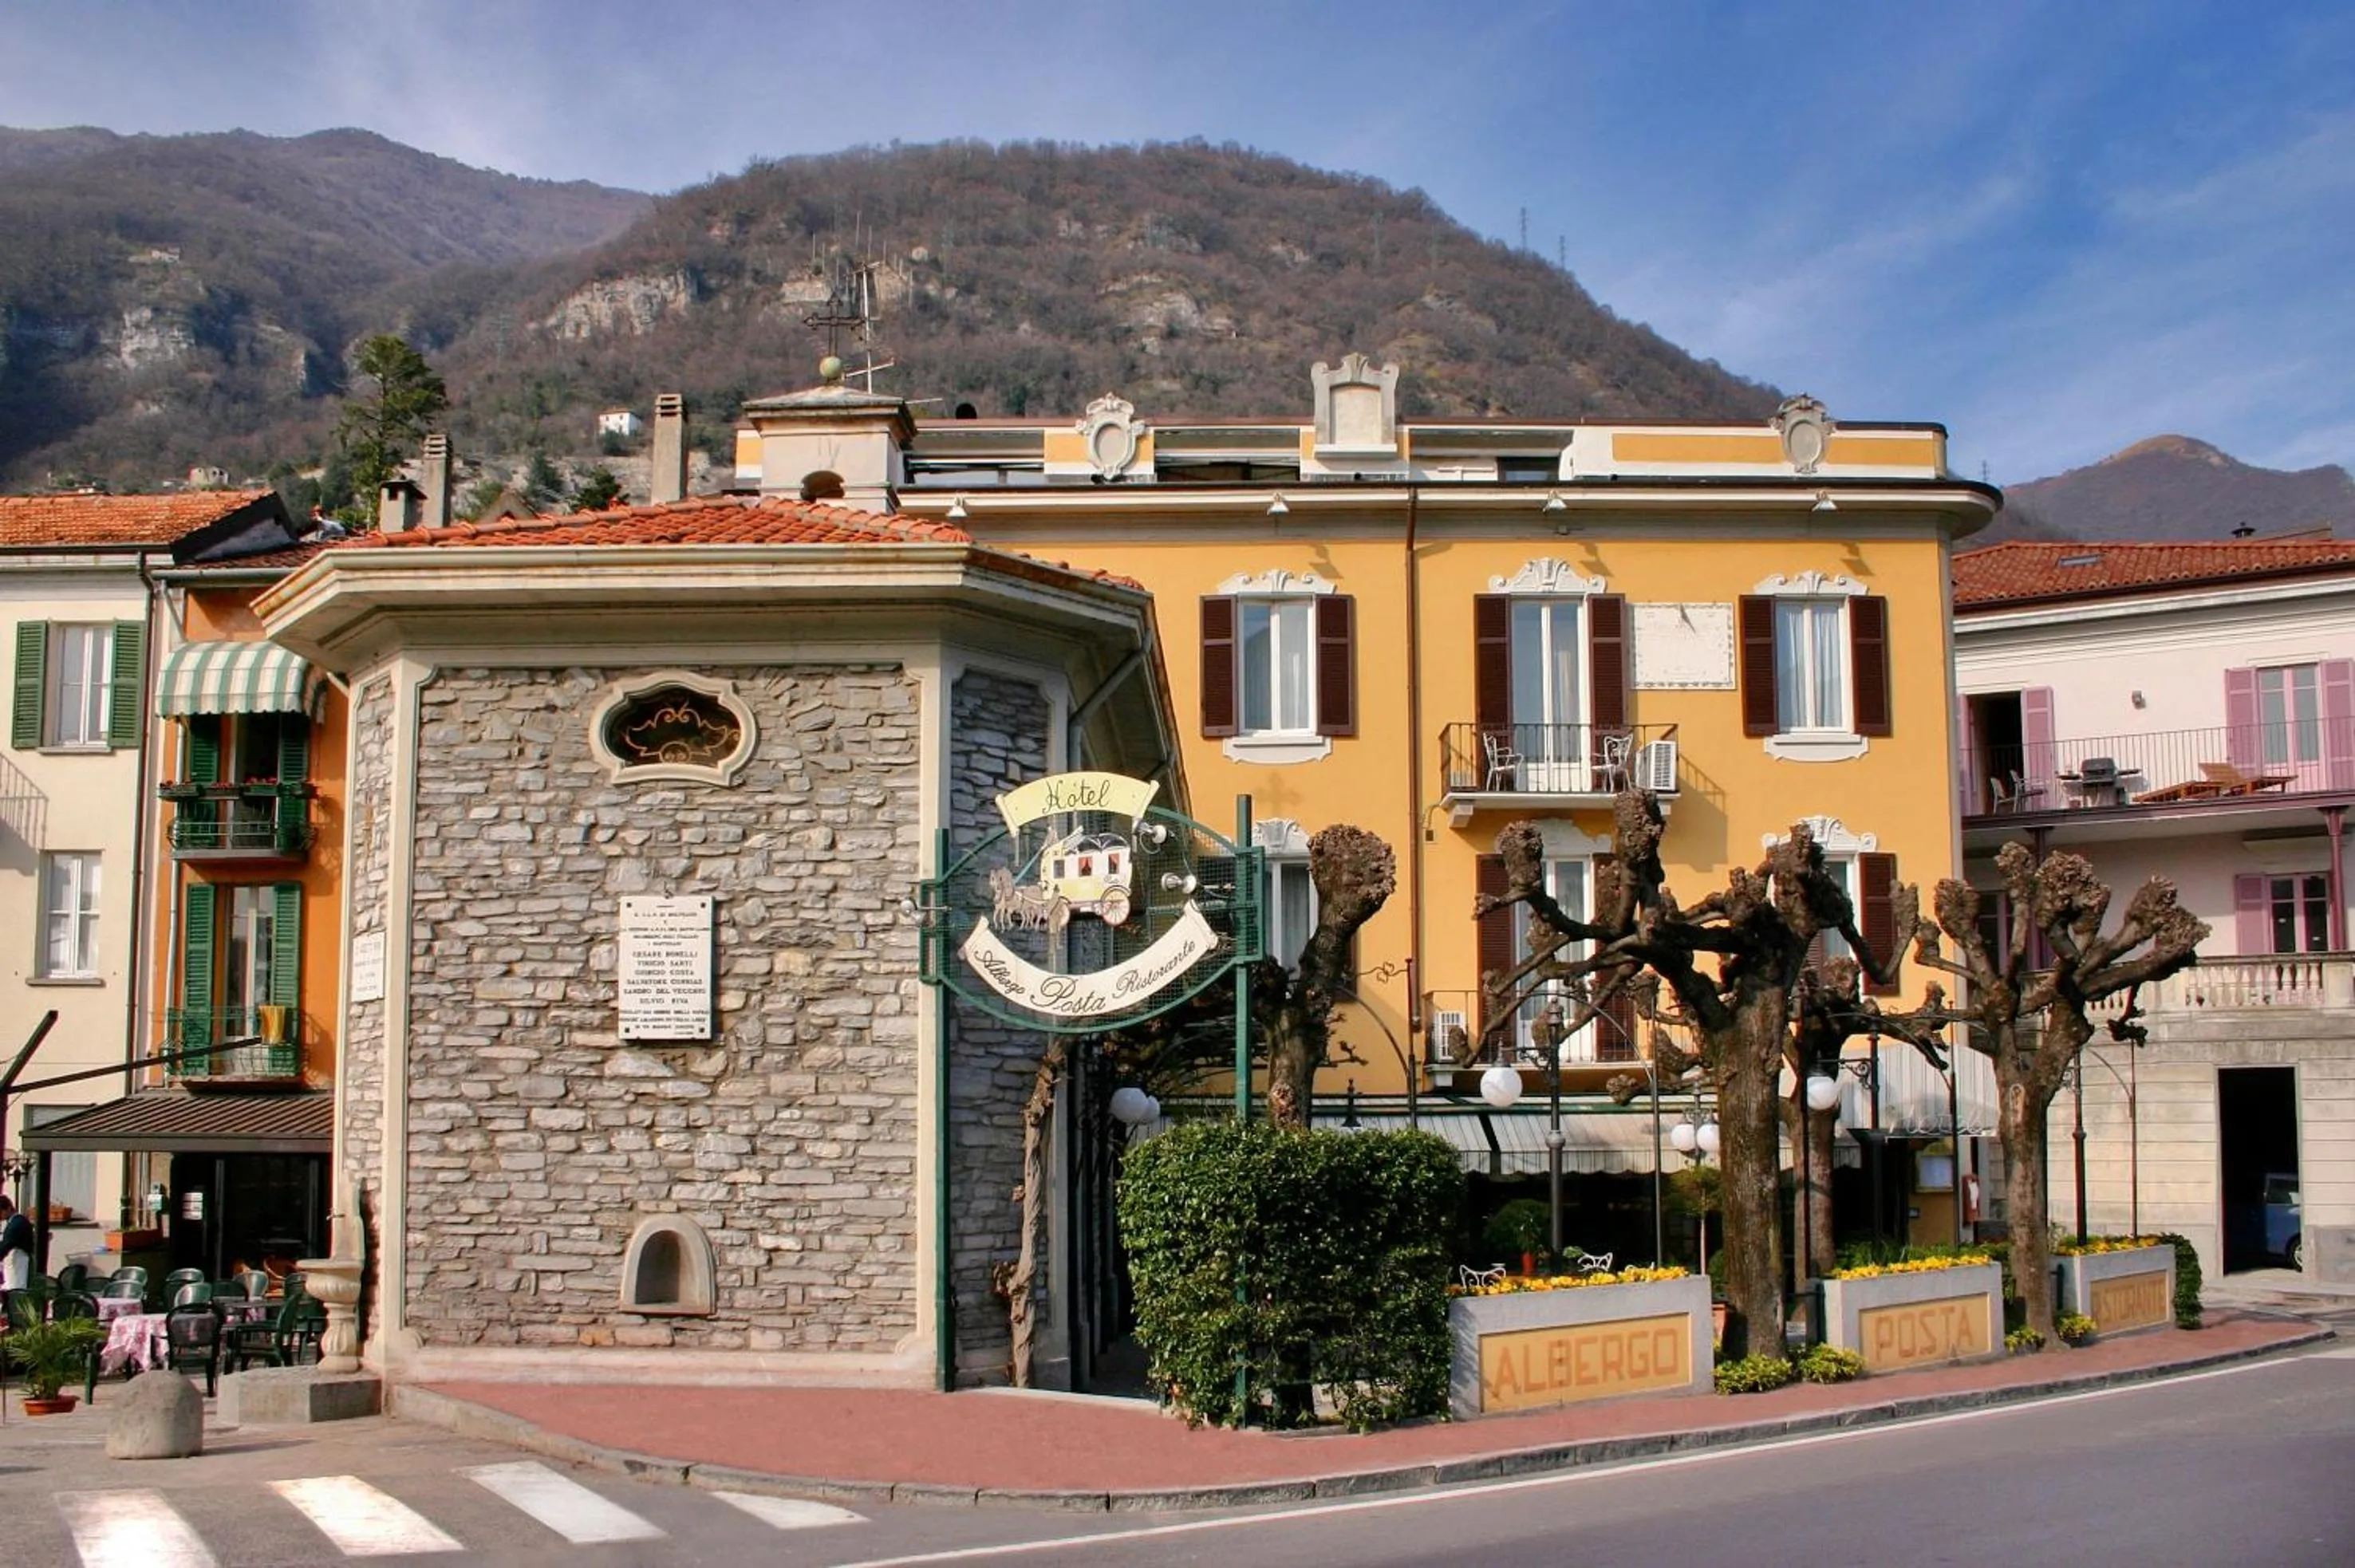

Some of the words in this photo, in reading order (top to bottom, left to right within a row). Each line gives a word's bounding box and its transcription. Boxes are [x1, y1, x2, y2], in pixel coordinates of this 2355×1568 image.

[1042, 778, 1110, 814] Hotel
[975, 950, 1026, 995] Albergo
[1030, 975, 1106, 1014] Posta
[1112, 939, 1195, 999] Ristorante
[1492, 1327, 1679, 1397] ALBERGO
[1874, 1305, 1974, 1363] POSTA
